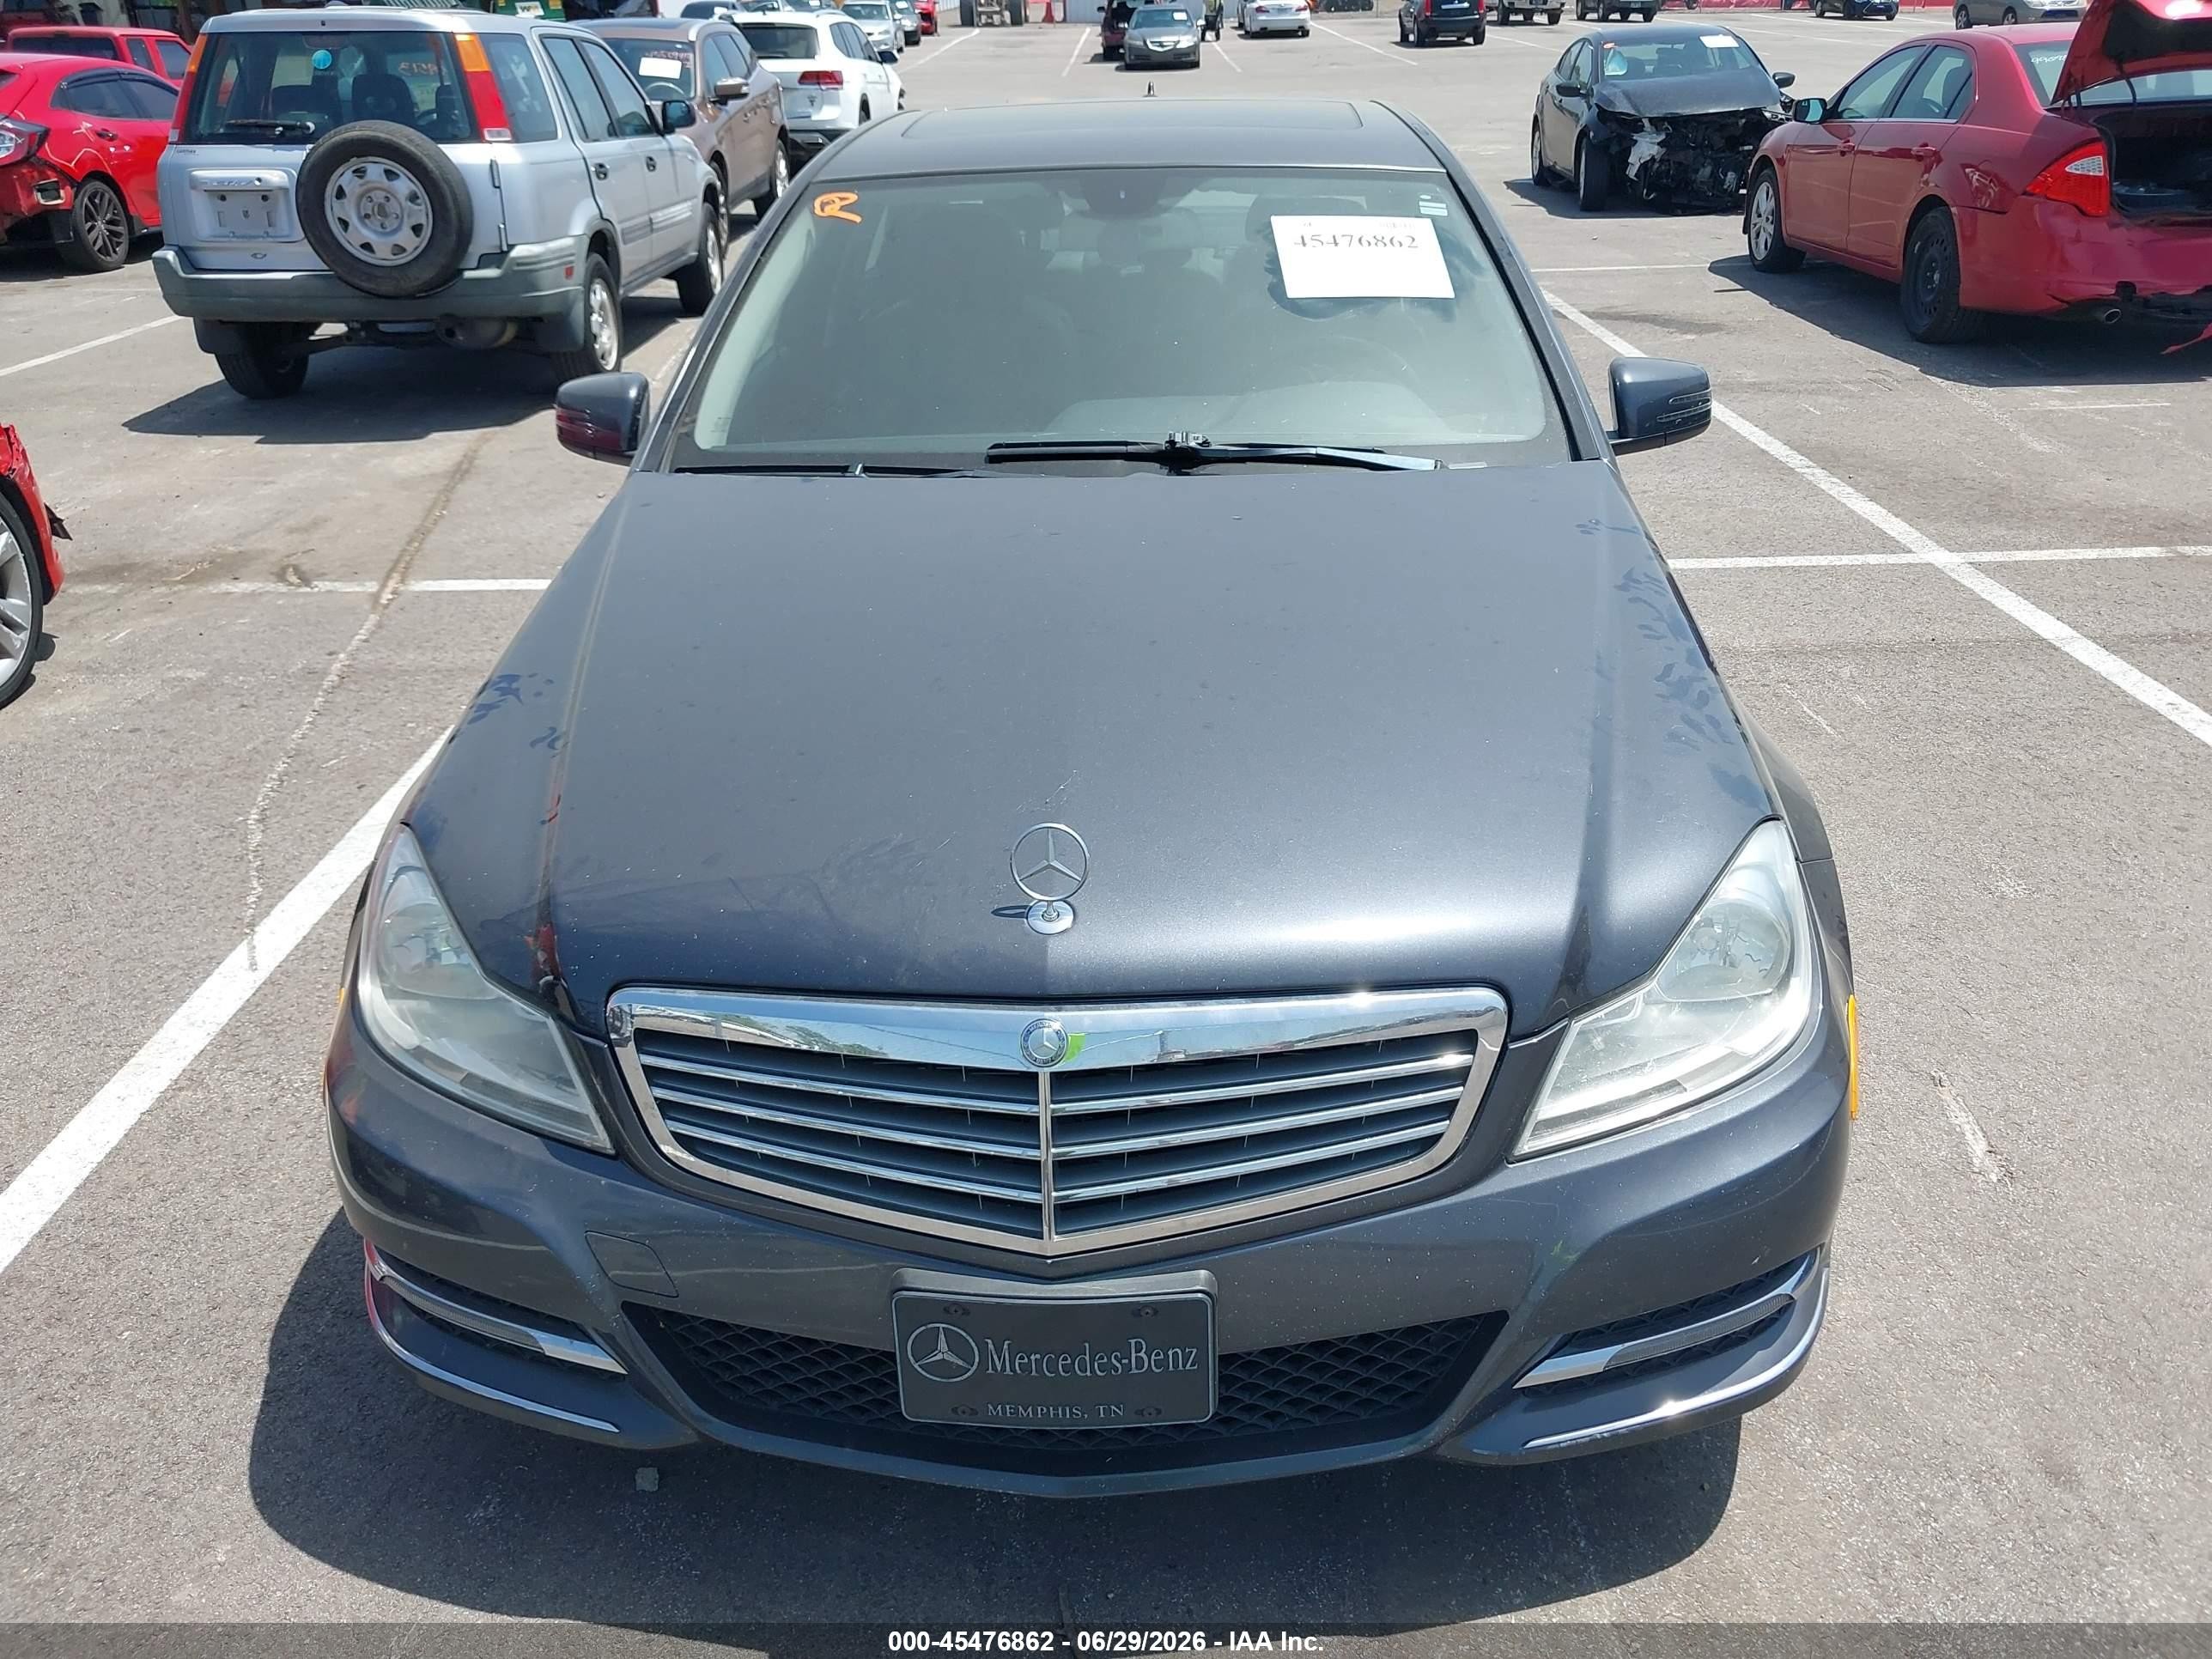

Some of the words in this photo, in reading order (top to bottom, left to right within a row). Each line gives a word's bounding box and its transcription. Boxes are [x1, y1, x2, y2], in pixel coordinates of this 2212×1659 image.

[1294, 234, 1419, 248] 45476862
[984, 1339, 1198, 1376] Mercedes-Benz
[988, 1403, 1088, 1419] MEMPHIS,
[1095, 1405, 1125, 1418] TN
